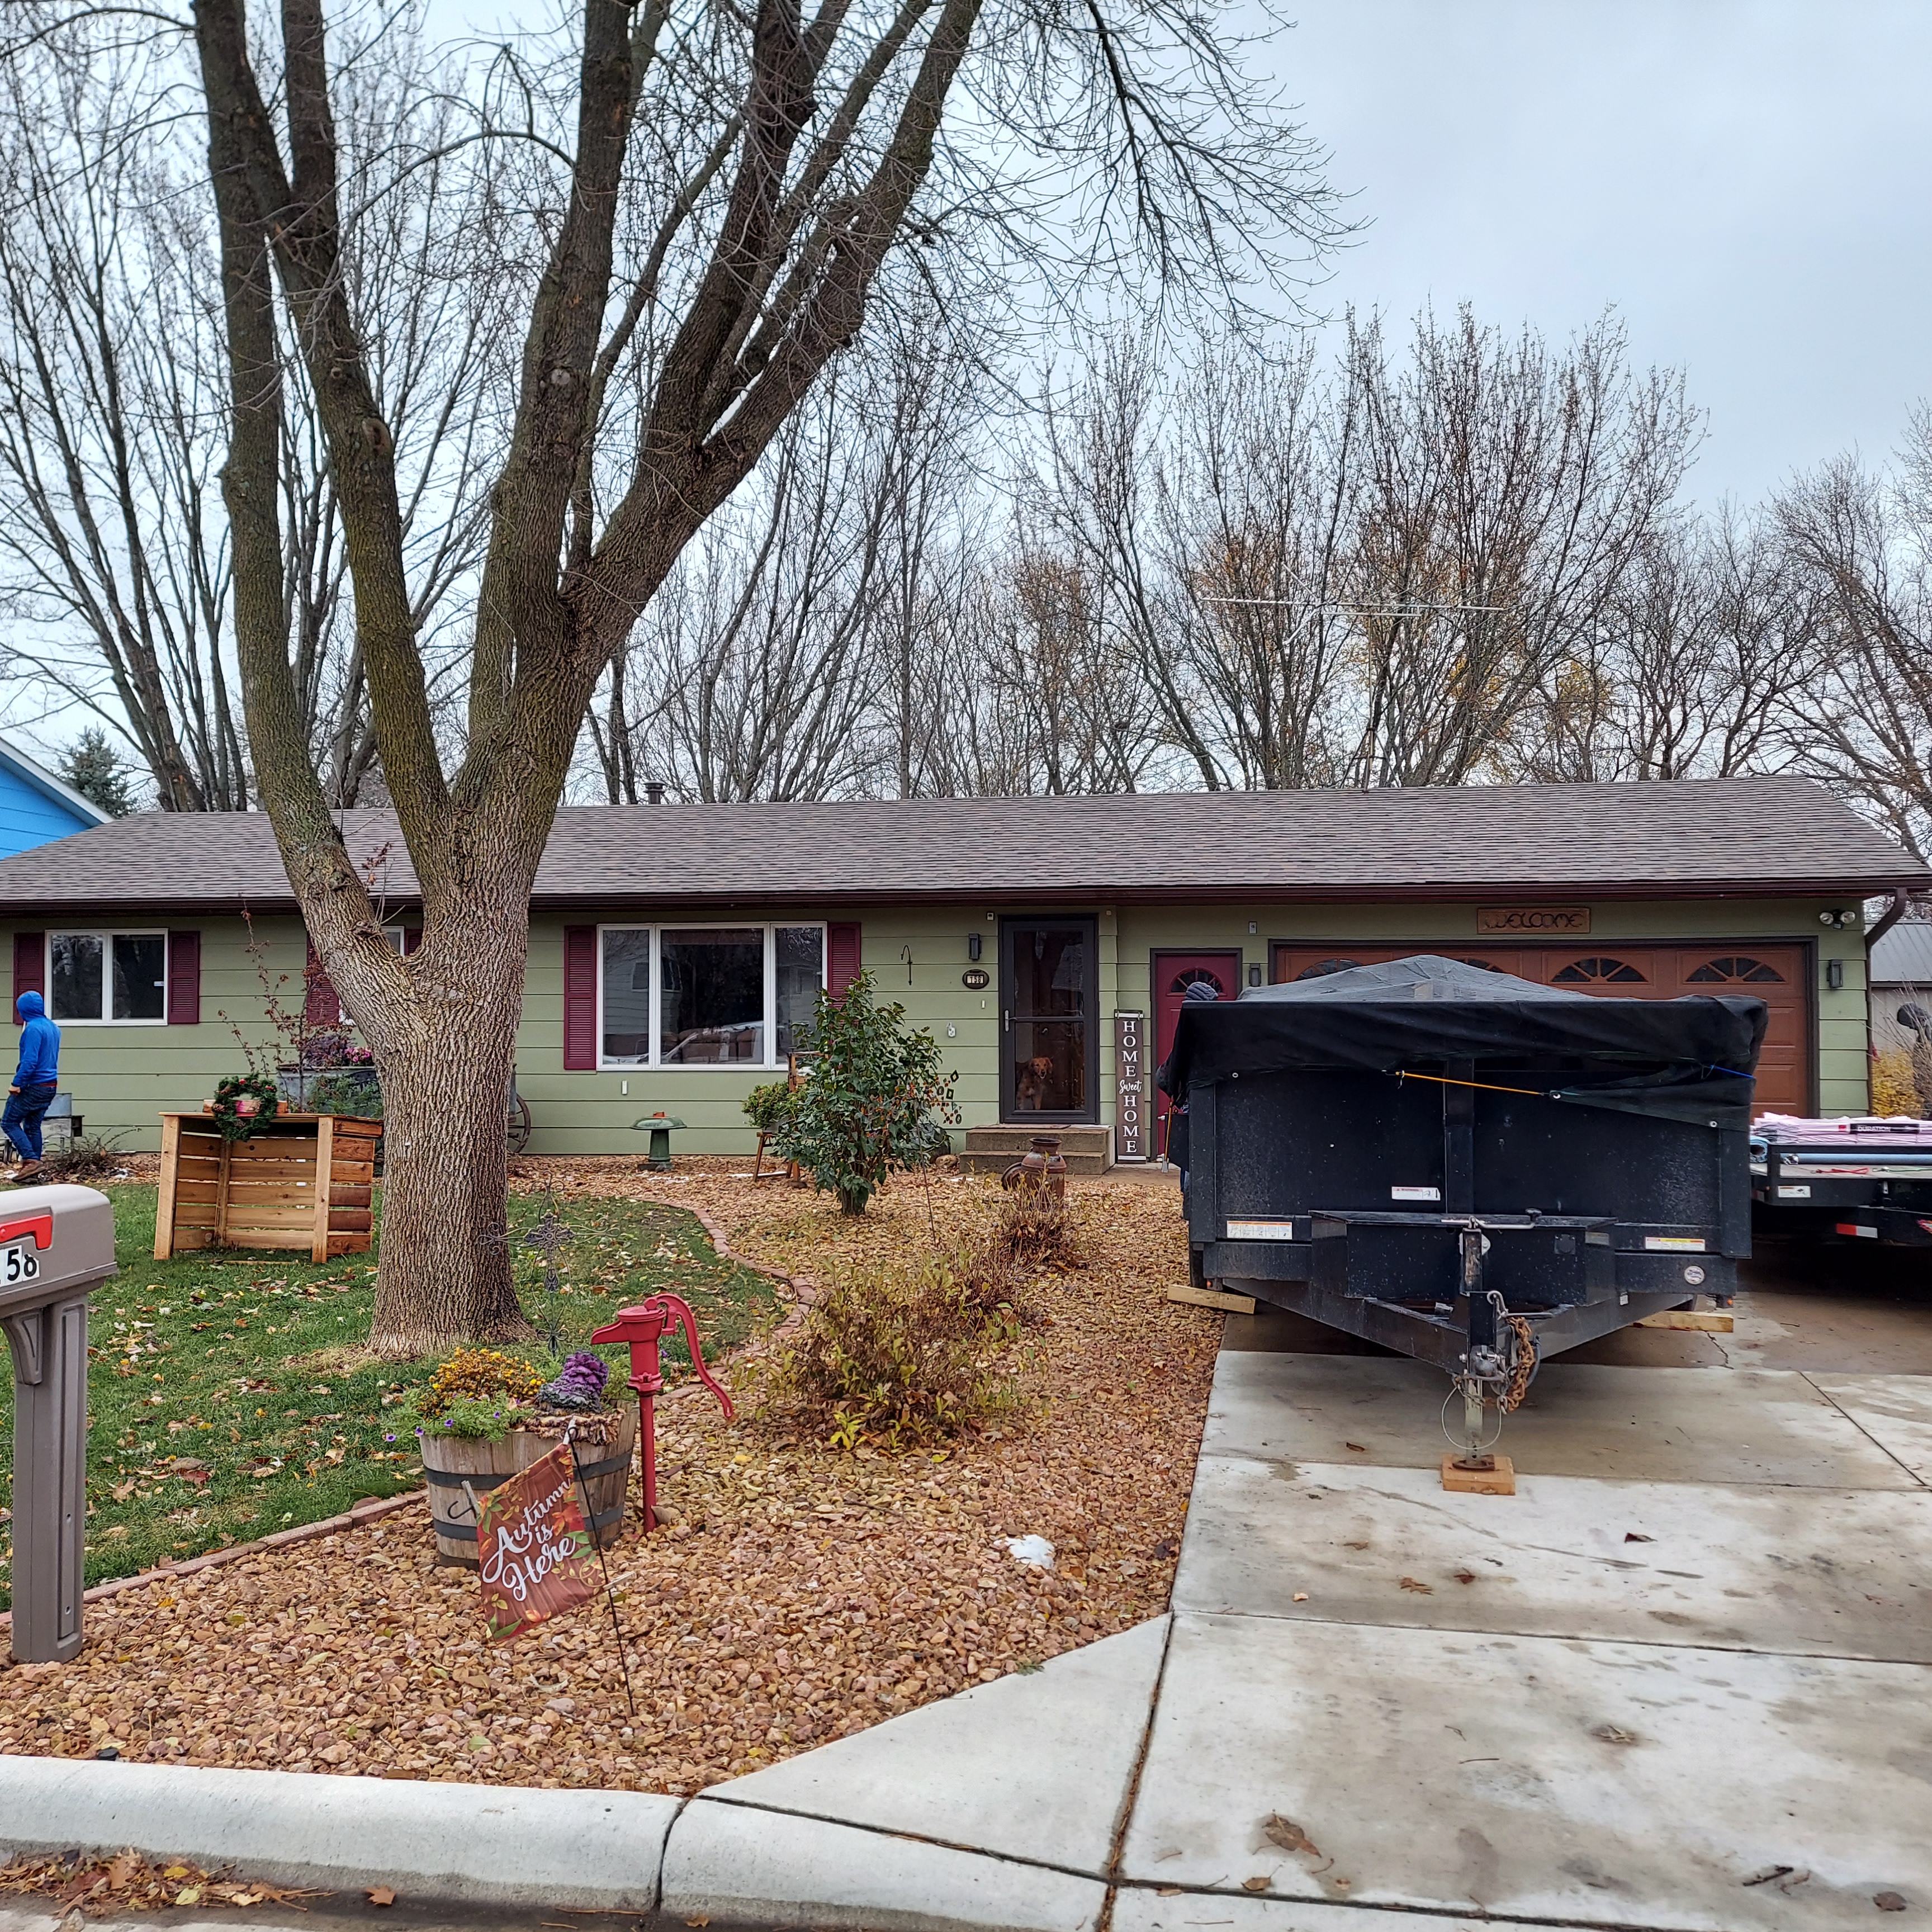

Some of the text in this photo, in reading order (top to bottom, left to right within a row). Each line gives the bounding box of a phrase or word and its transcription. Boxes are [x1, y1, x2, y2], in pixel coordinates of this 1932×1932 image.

[1121, 1020, 1139, 1077] HOME
[1119, 1079, 1142, 1094] Sweet
[1123, 1095, 1140, 1153] HOME
[482, 1478, 571, 1584] Autumn
[535, 1523, 554, 1545] is
[503, 1536, 576, 1601] Here
